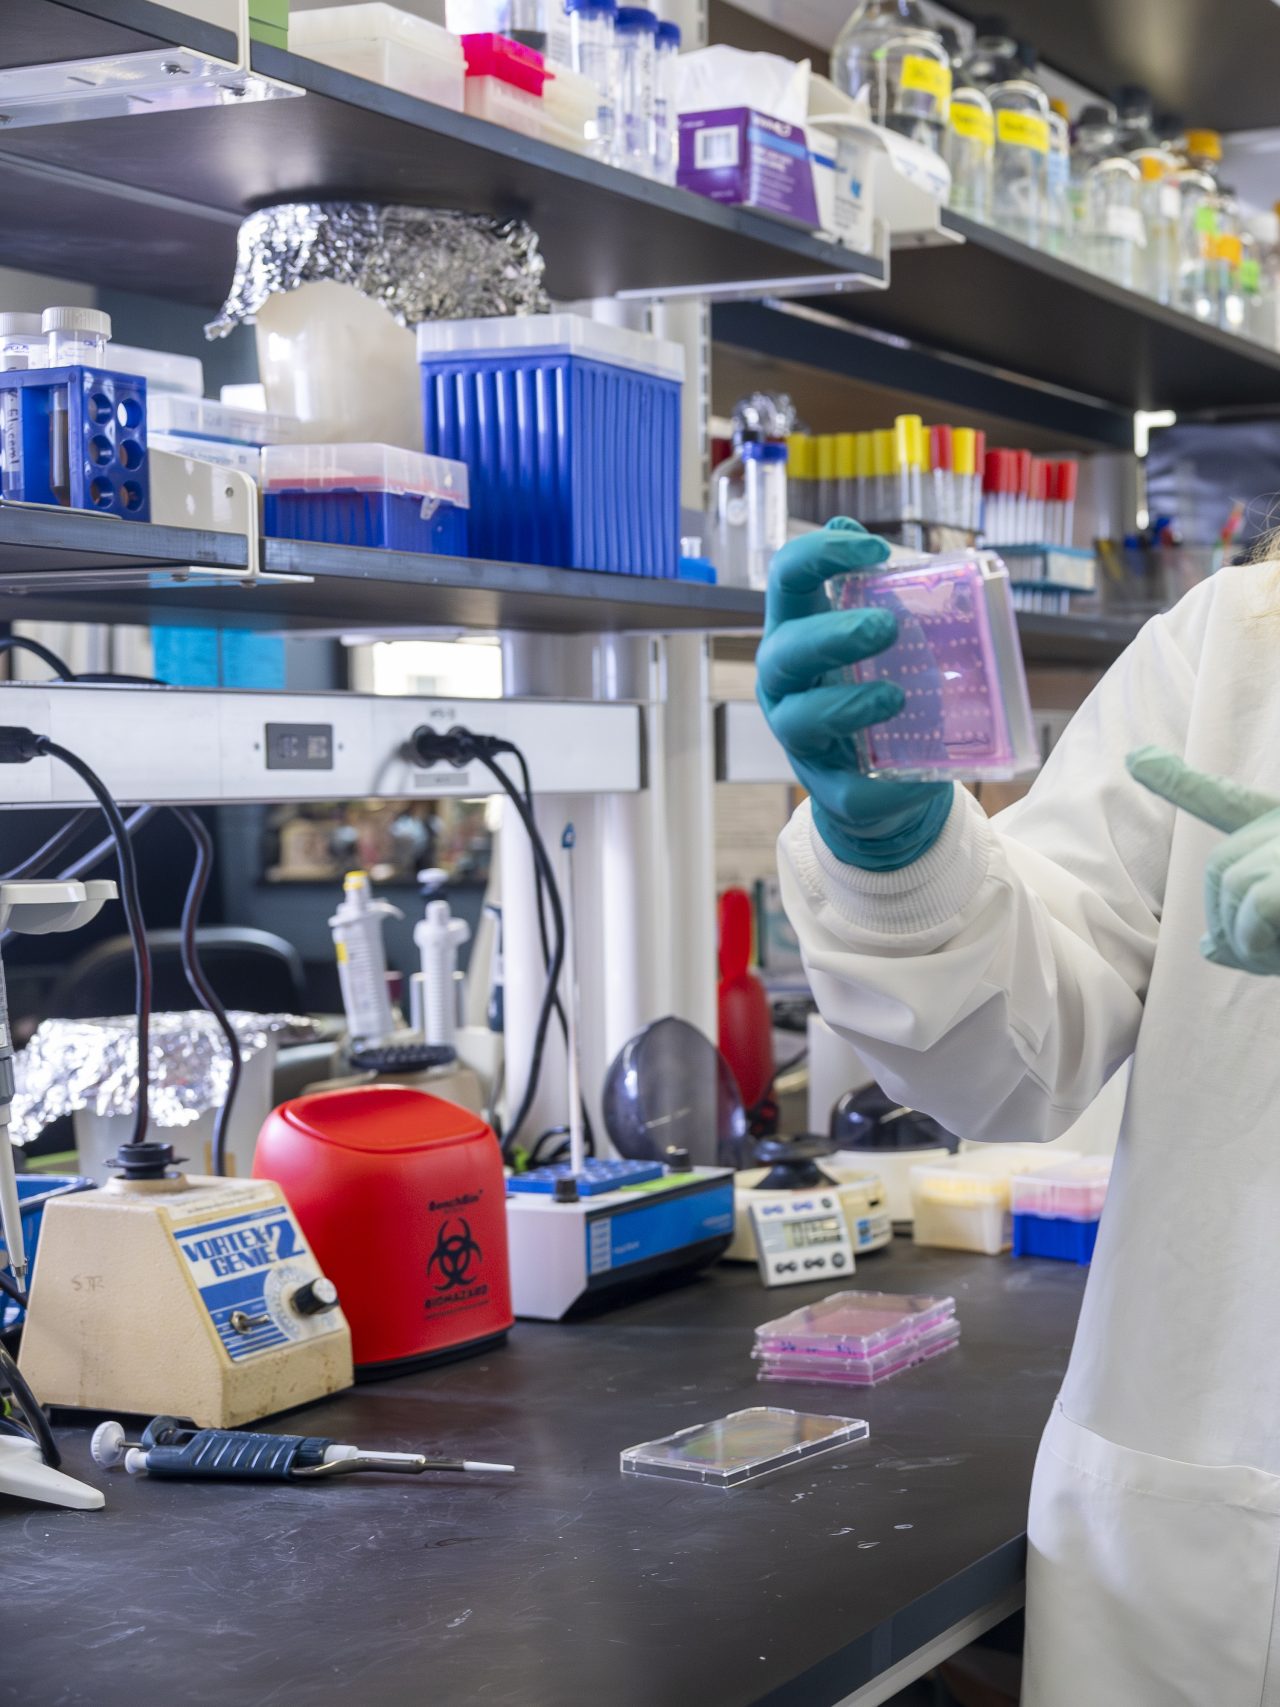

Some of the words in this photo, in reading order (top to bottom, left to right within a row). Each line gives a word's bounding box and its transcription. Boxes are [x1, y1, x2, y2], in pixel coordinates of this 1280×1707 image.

[210, 1247, 277, 1277] GENIE
[265, 1219, 306, 1260] 2
[425, 1284, 488, 1309] BIOHAZARD
